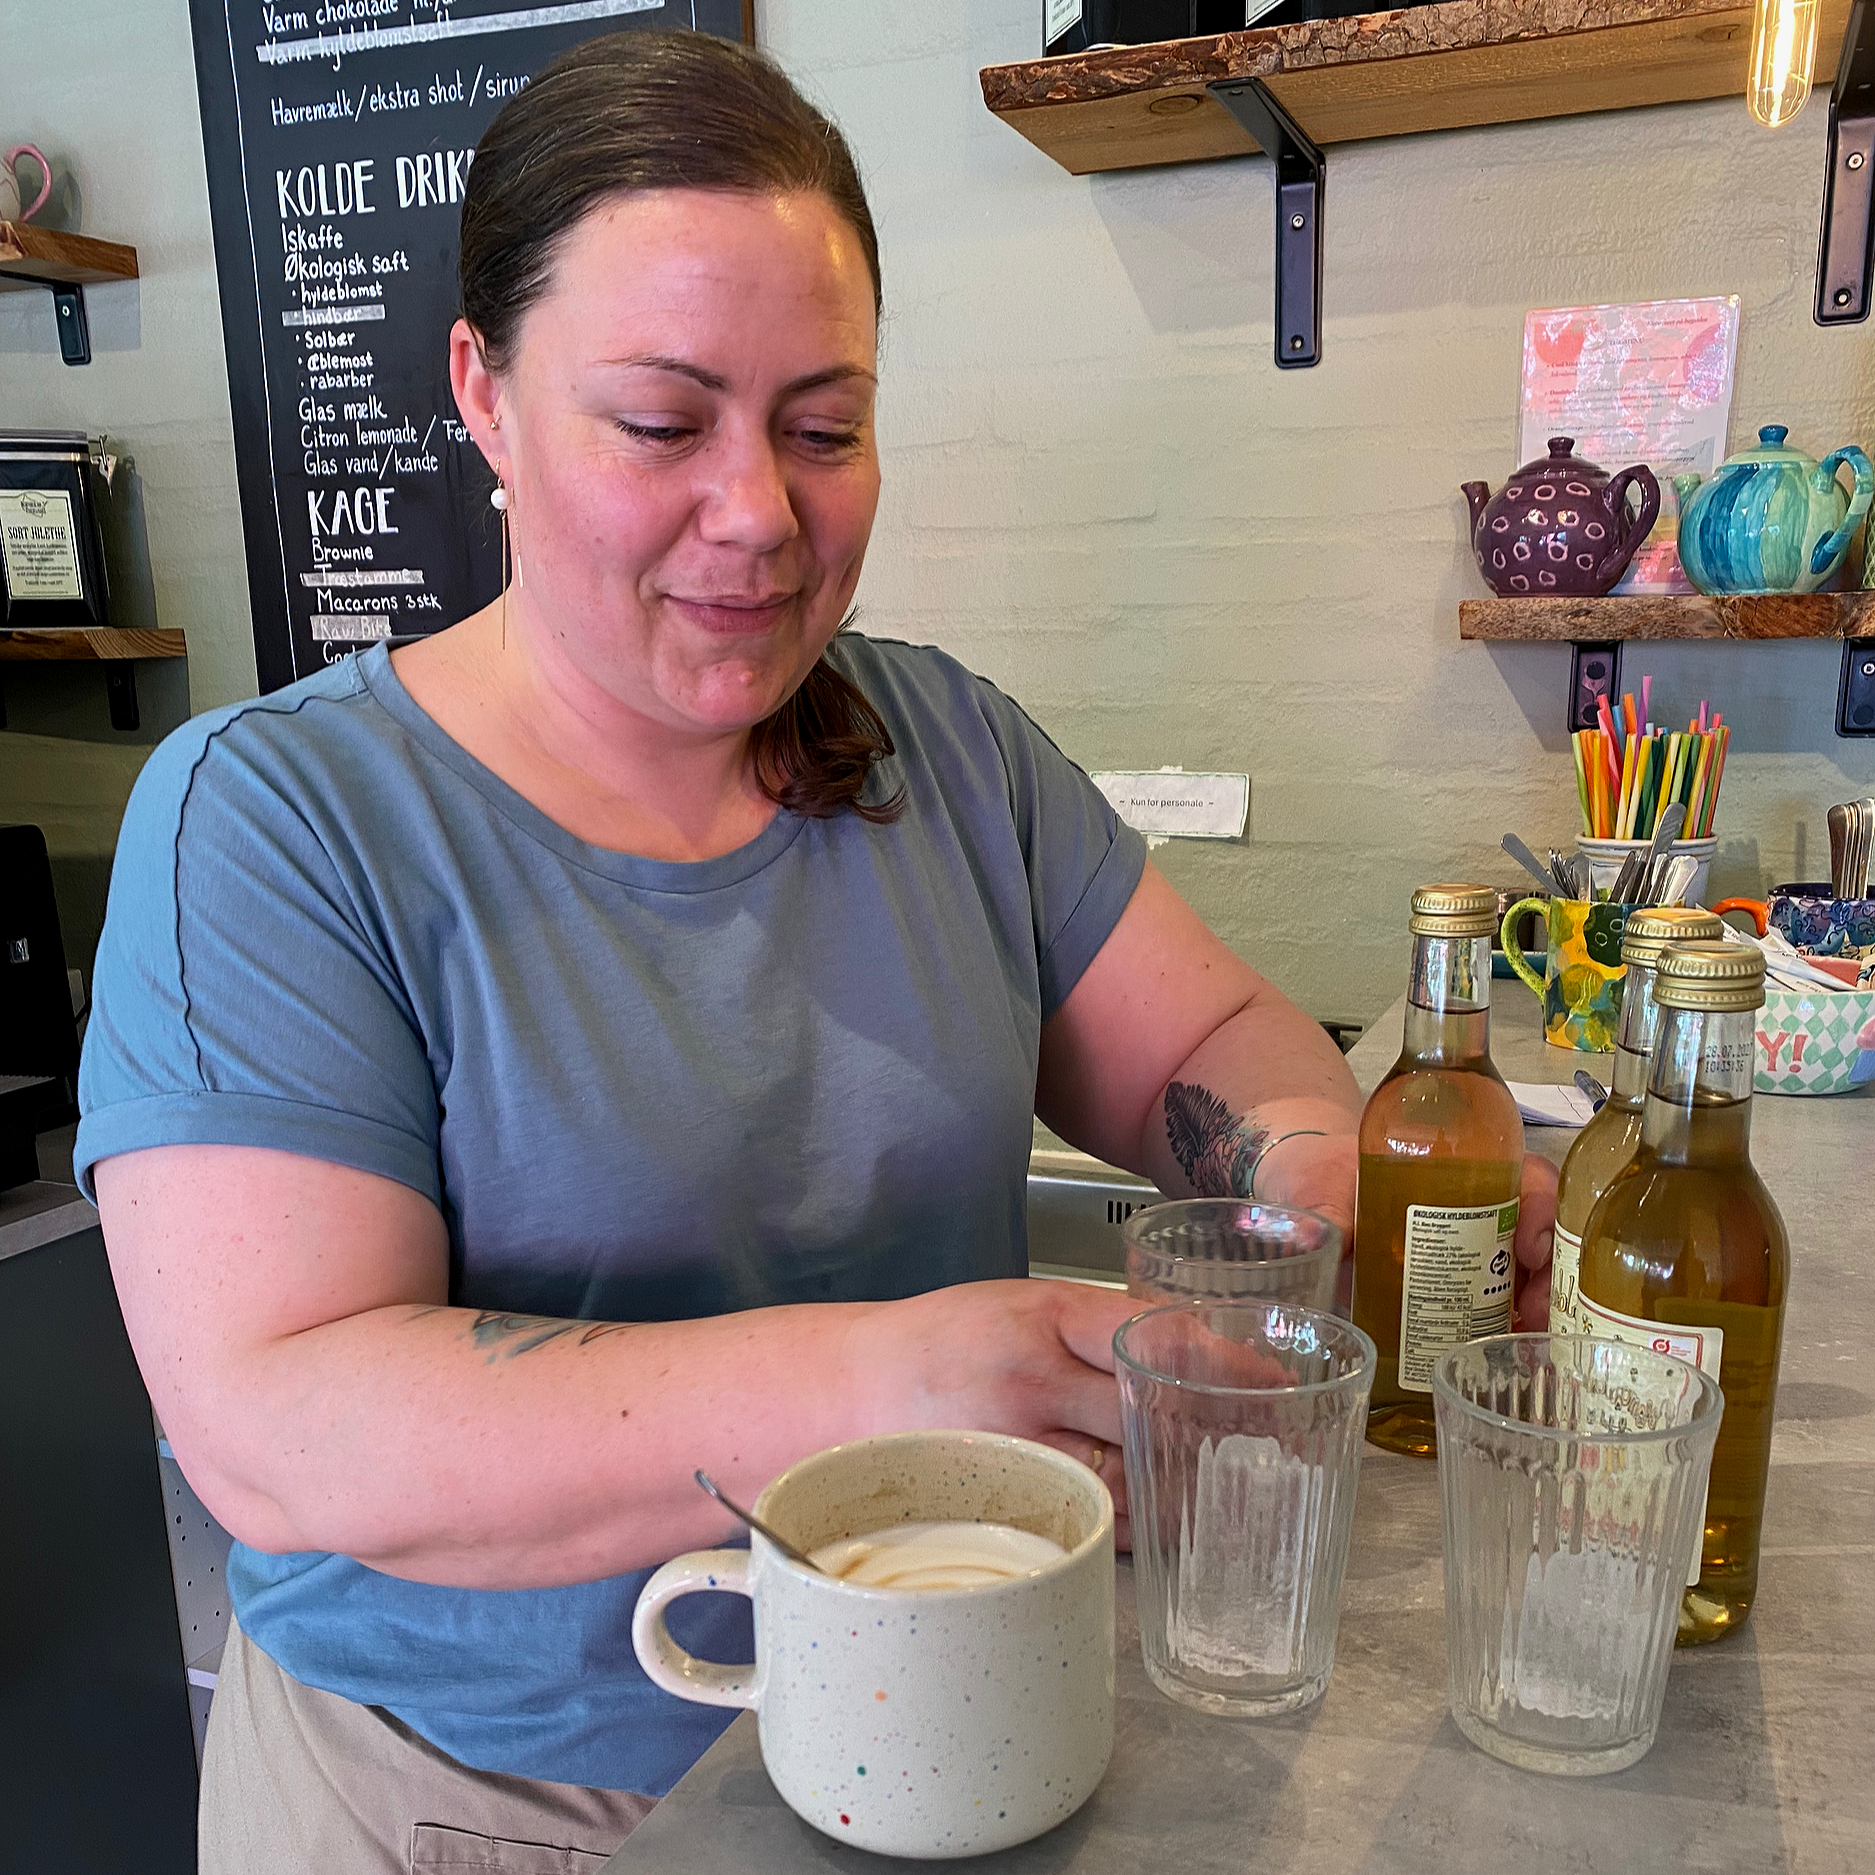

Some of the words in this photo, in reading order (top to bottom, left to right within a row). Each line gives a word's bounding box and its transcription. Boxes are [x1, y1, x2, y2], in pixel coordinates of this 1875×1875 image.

[262, 4, 309, 34] Varm
[315, 0, 399, 25] chokolade
[276, 159, 376, 219] KOLDE
[395, 148, 476, 209] DRIK
[281, 222, 344, 253] Iskaffe
[284, 251, 368, 283] Økologisk
[371, 250, 410, 273] saft
[300, 280, 383, 308] hyldeblomst
[309, 370, 375, 391] rabarber
[298, 395, 336, 423] Glas
[343, 394, 388, 419] mælk
[300, 424, 349, 449] Citron
[356, 414, 418, 446] lemonade
[442, 419, 475, 443] Fer
[304, 449, 338, 477] Glas
[307, 486, 399, 536] KAGE
[312, 537, 374, 563] Brownie
[316, 588, 399, 613] Macarons
[1130, 797, 1146, 807] Kun
[1147, 797, 1159, 807] for
[1160, 798, 1204, 808] personale
